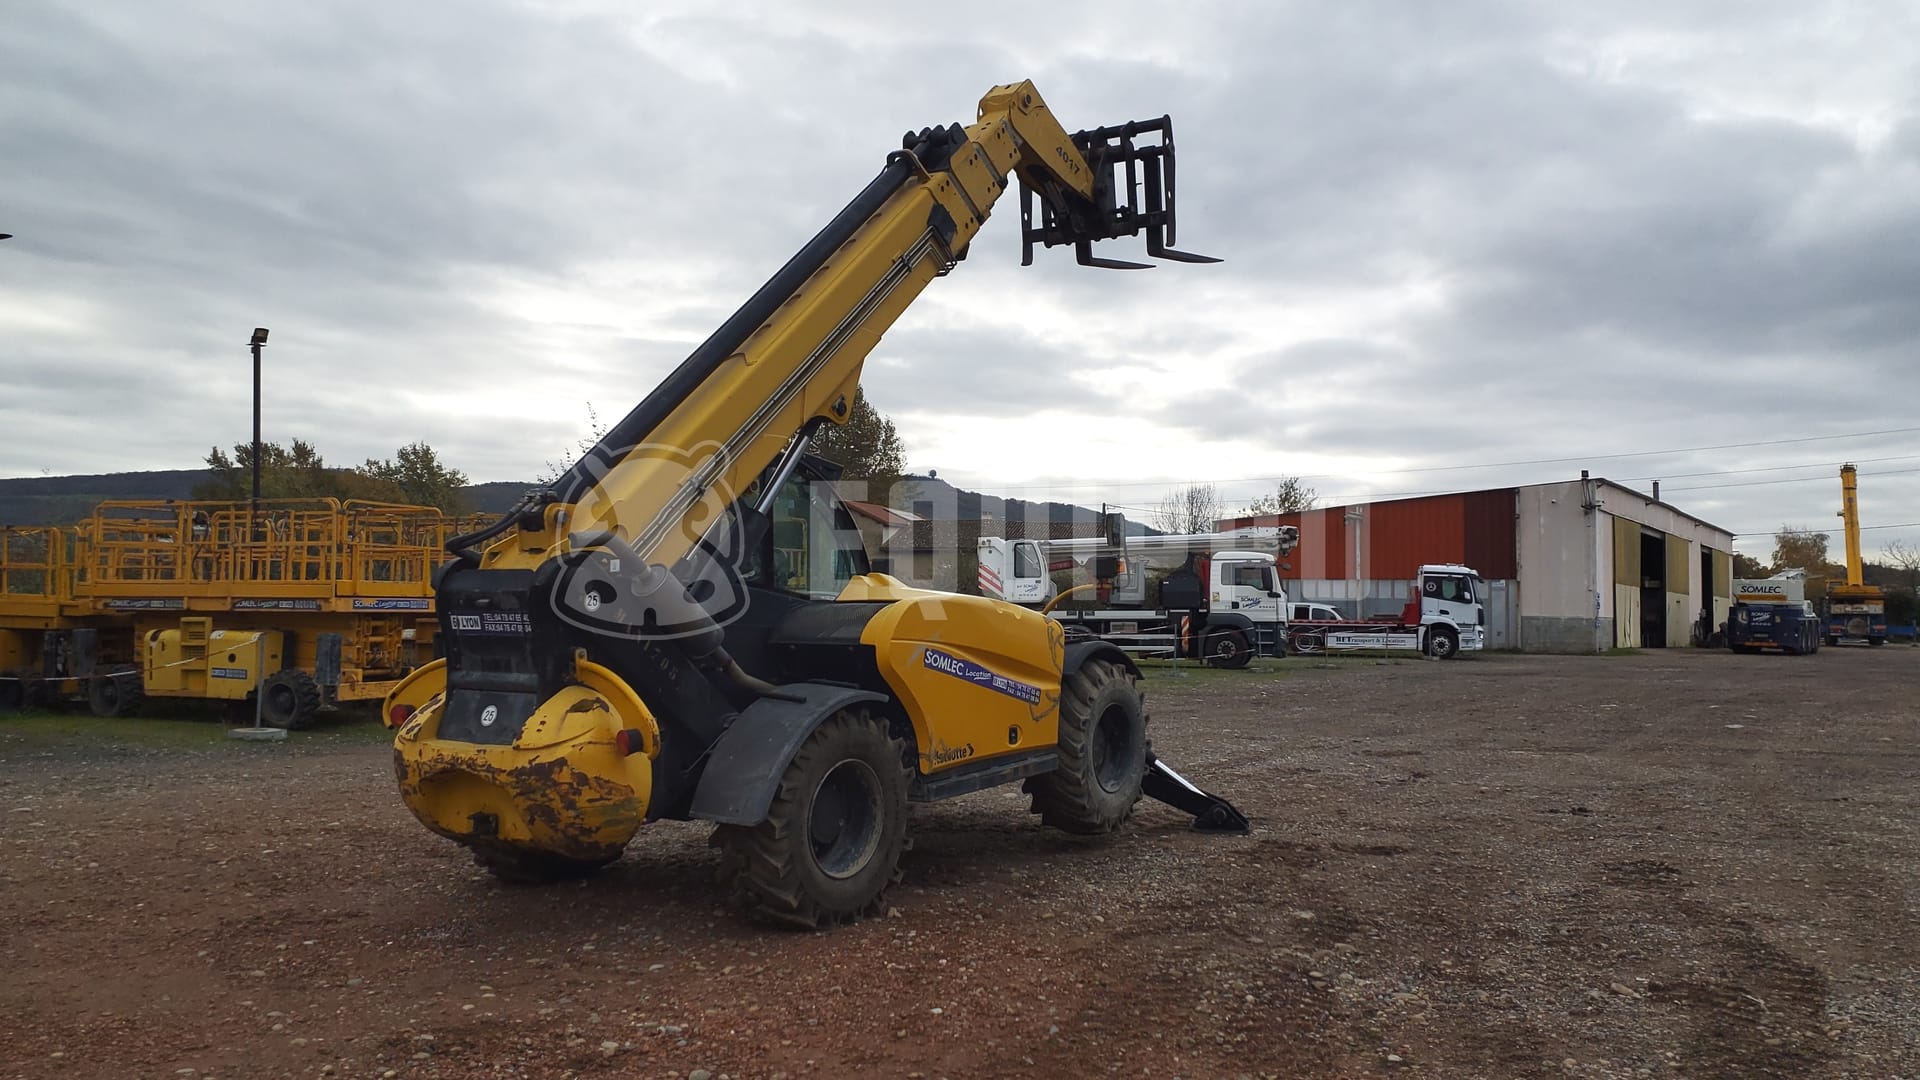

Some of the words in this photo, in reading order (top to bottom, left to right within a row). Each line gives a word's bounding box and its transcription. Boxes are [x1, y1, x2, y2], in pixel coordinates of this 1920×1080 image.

[1056, 146, 1080, 174] 4017
[1741, 585, 1782, 593] SOMLEC
[587, 595, 598, 607] 25
[461, 617, 480, 628] LYON
[924, 650, 964, 676] SOMLEC
[965, 668, 992, 679] Location
[483, 710, 496, 722] 25
